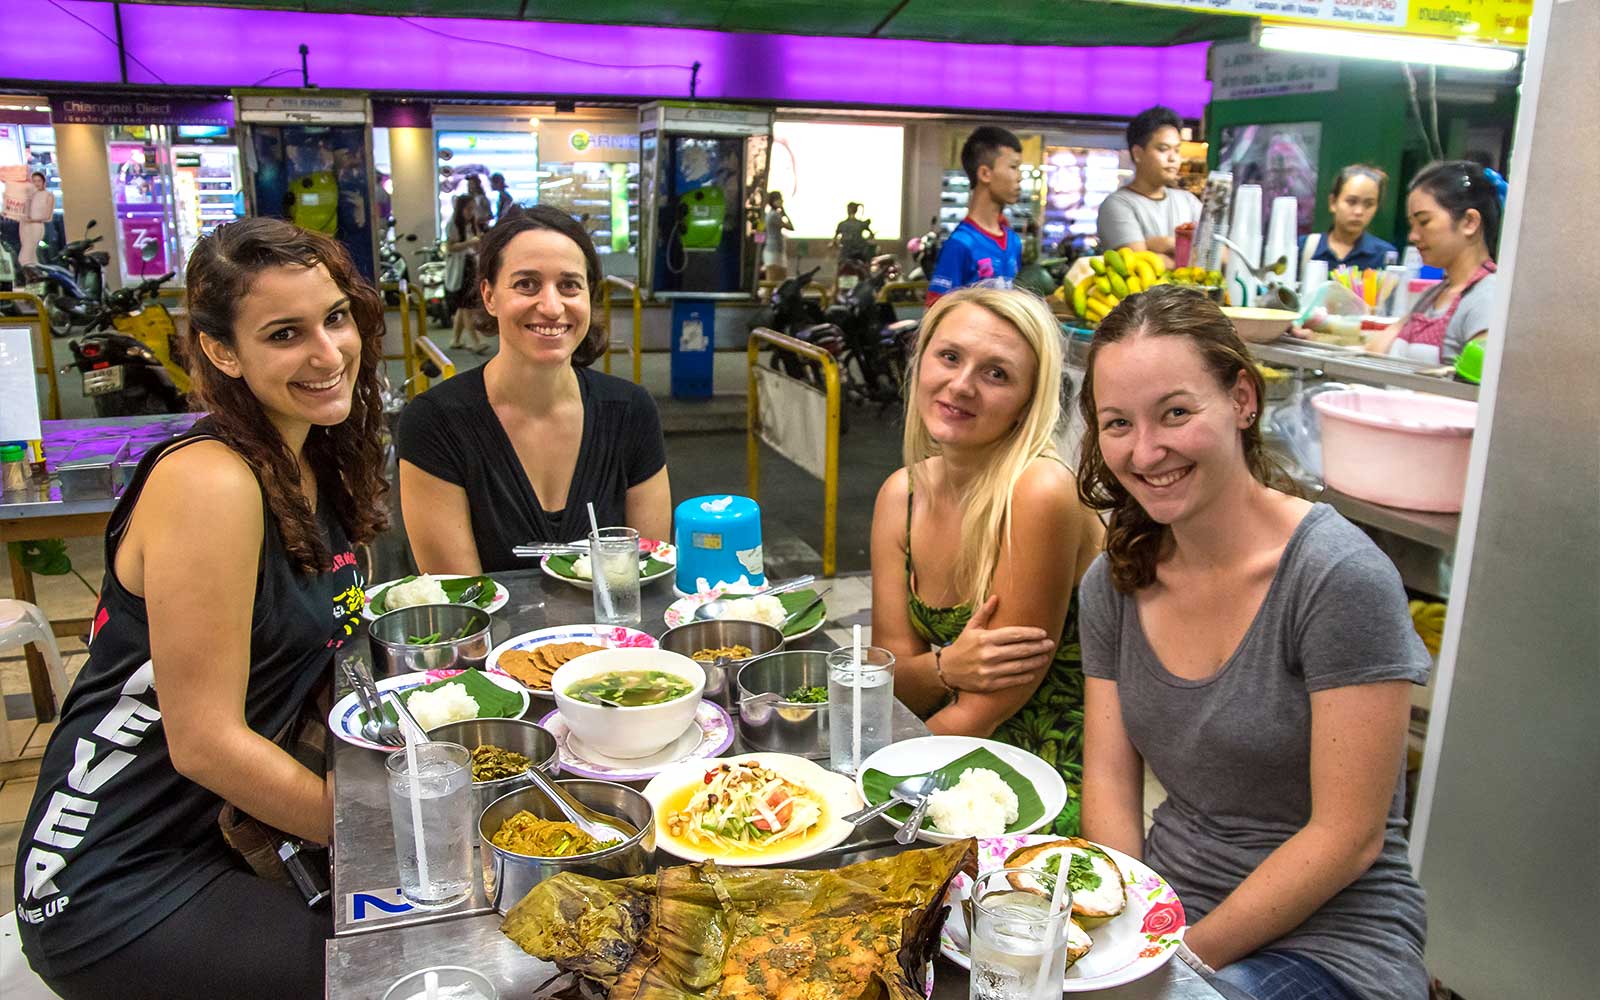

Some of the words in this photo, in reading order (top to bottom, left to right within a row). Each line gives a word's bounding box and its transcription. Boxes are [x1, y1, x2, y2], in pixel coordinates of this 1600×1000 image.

[63, 101, 132, 115] Chiangmai
[571, 132, 641, 151] GARNIE
[46, 895, 70, 918] UP
